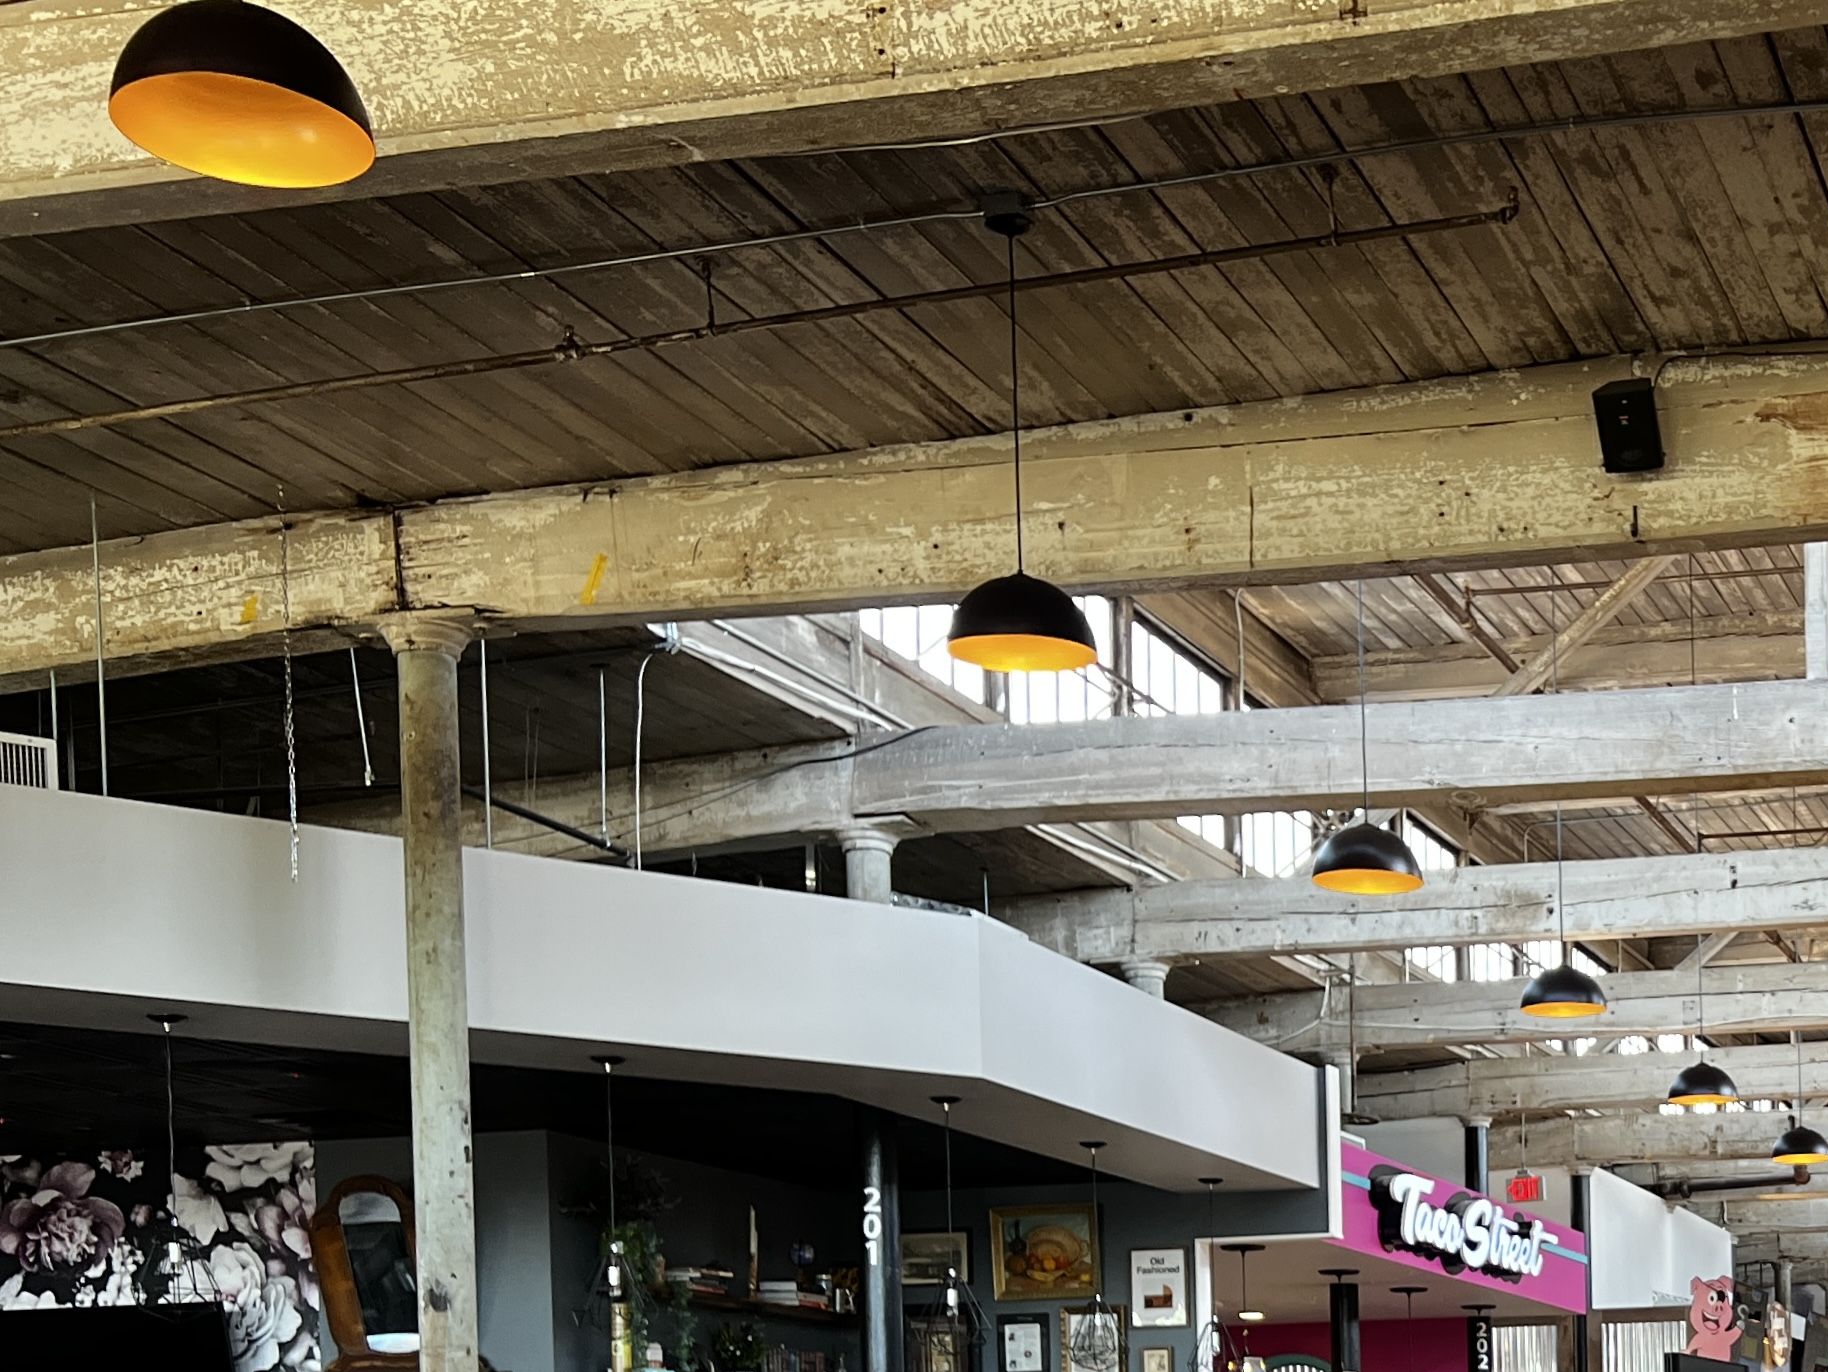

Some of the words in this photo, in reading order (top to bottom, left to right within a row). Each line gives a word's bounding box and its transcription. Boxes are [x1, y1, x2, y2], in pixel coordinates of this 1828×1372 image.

[863, 1186, 882, 1266] 201
[1389, 1173, 1464, 1254] Taco
[1460, 1199, 1559, 1277] Street
[1136, 1265, 1180, 1275] Fashioned
[1149, 1256, 1165, 1265] Old
[1476, 1322, 1489, 1370] 202
